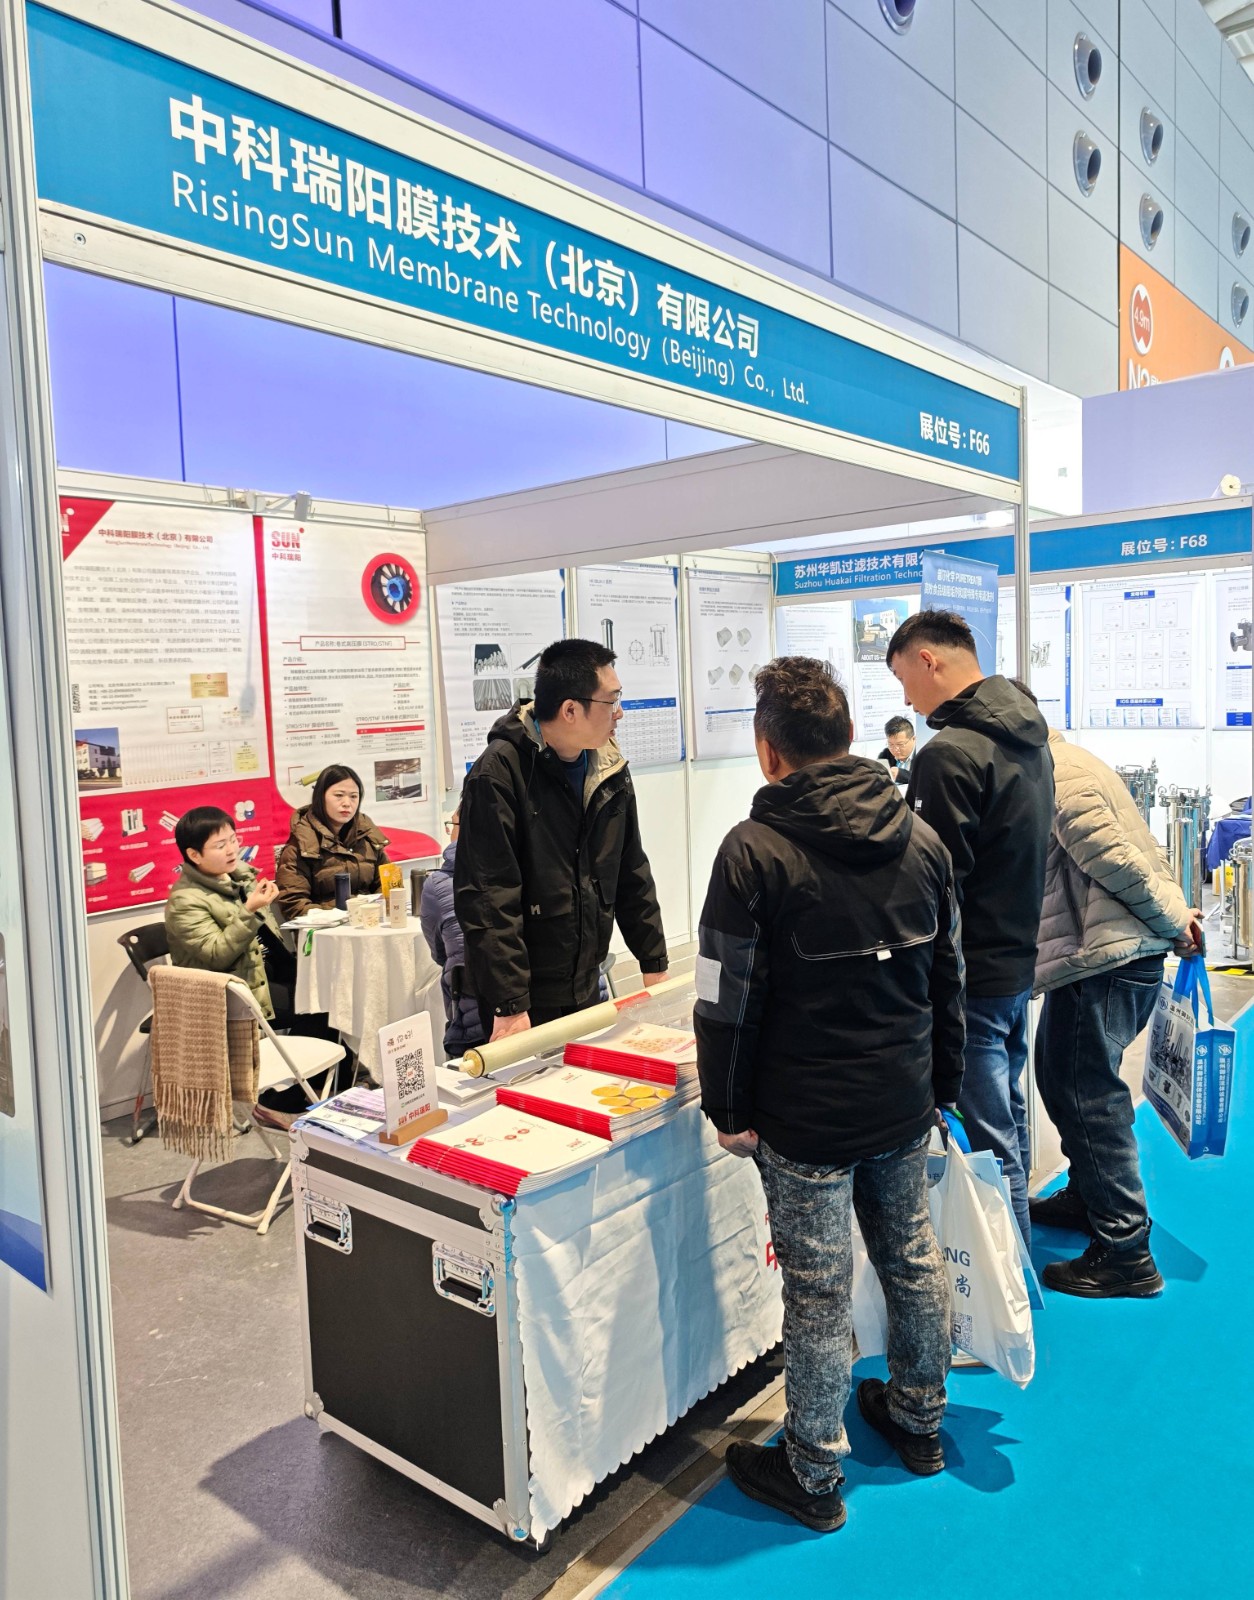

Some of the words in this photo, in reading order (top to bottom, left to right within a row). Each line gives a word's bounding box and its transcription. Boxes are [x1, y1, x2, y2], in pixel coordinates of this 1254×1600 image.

[170, 95, 758, 358] 中科瑞阳膜技术（北京）有限公司
[173, 171, 354, 262] RisingSun
[369, 238, 519, 313] Membrane
[528, 290, 651, 361] Technology
[745, 365, 777, 393] Co.,
[783, 378, 809, 404] Ltd.
[1134, 307, 1150, 332] 4.9m
[795, 550, 946, 580] 苏州华凯过滤技术有限
[795, 579, 822, 590] Suzhou
[824, 575, 852, 586] Huakai
[854, 572, 893, 584] Filtration
[894, 569, 923, 580] Techno
[944, 1246, 970, 1267] NG
[955, 1273, 971, 1298] 尚
